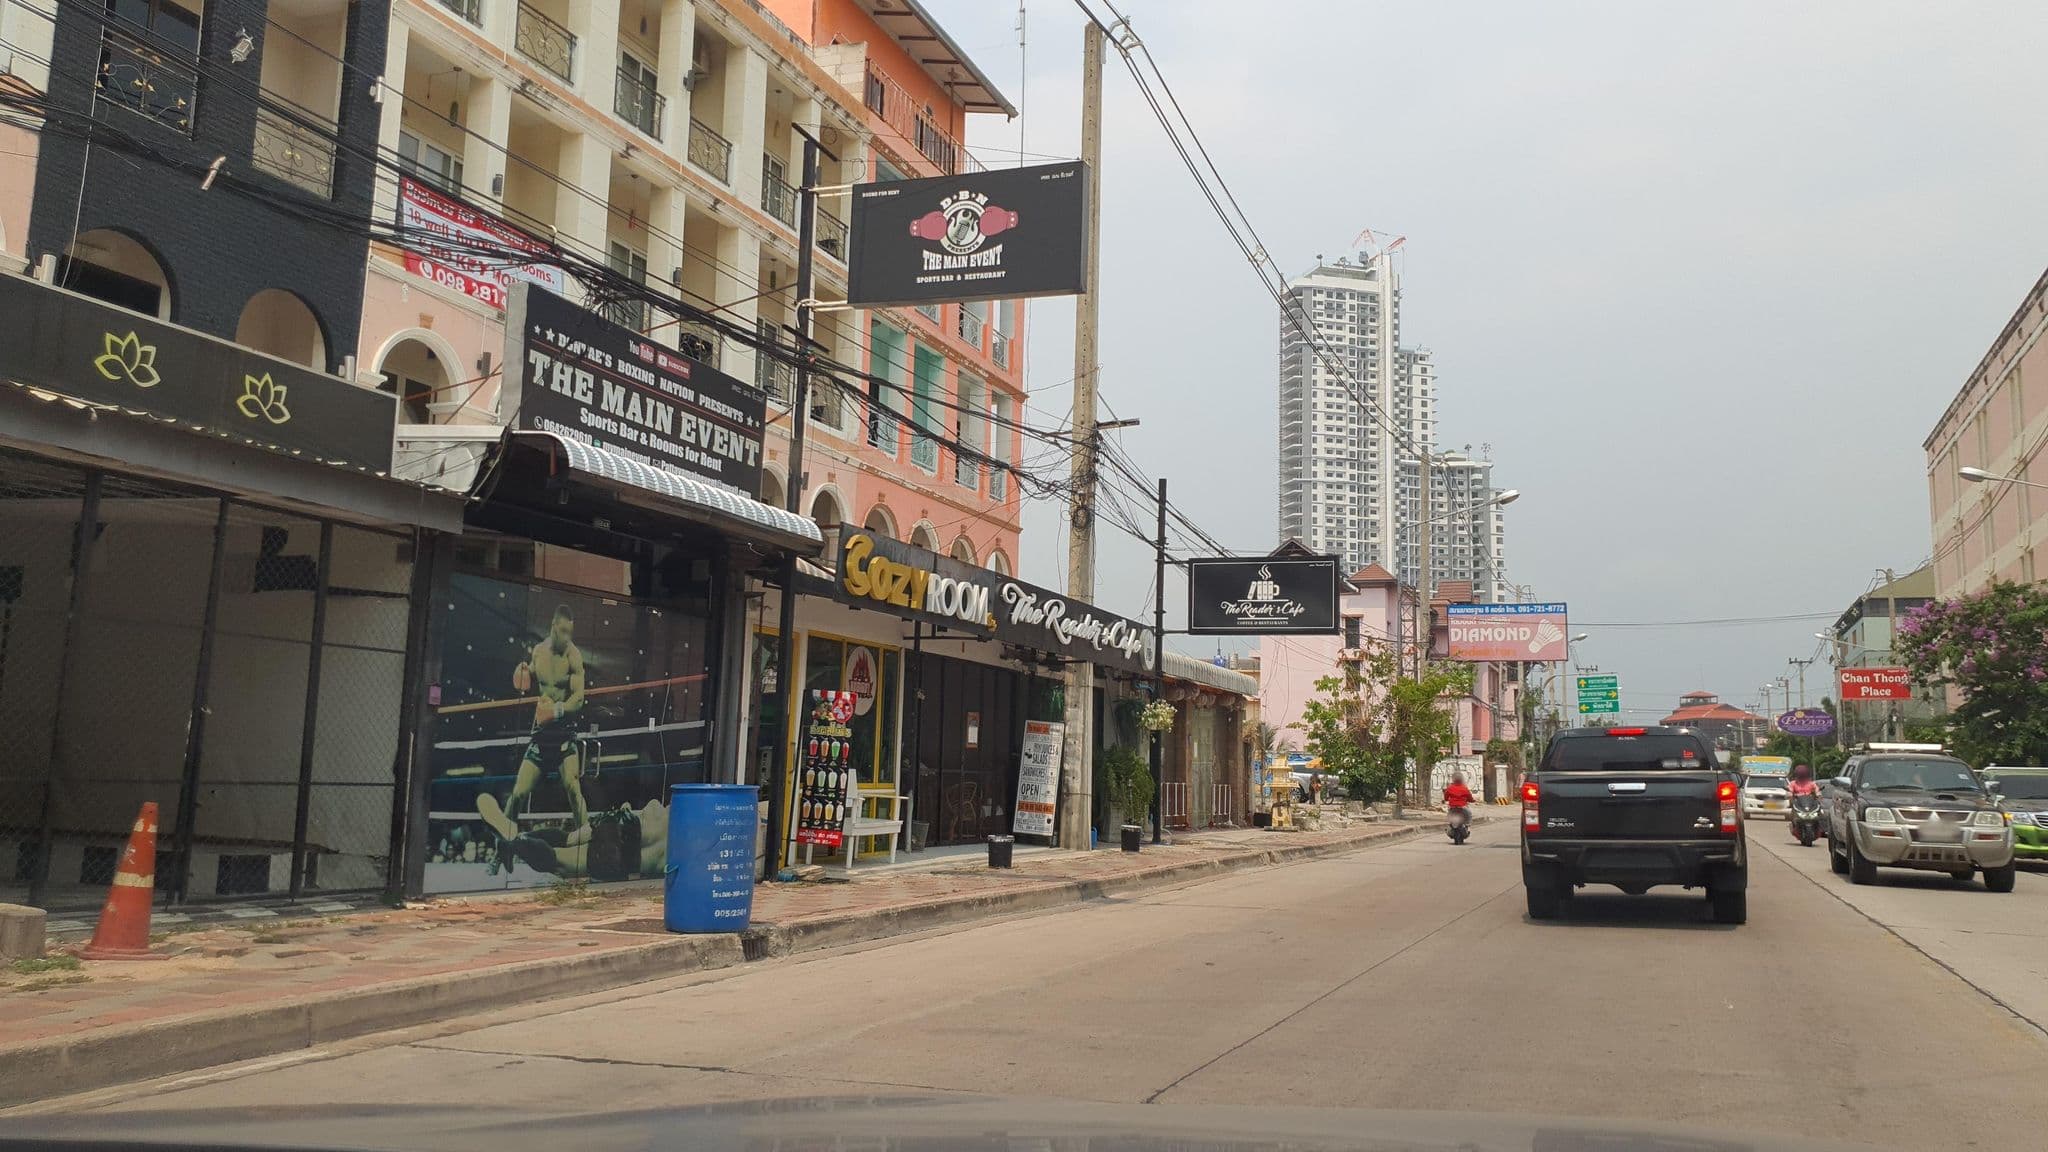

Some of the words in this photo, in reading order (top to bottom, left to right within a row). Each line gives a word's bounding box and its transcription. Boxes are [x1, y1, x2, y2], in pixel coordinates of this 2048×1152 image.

[923, 249, 942, 270] THE
[943, 254, 969, 269] MAIN
[969, 243, 1003, 268] EVENT
[436, 268, 466, 293] 098
[519, 263, 555, 285] ooms.
[916, 276, 941, 284] SPORTS
[941, 274, 954, 282] BAR
[956, 273, 962, 281] &
[964, 271, 1007, 281] RESTAURANT
[617, 359, 655, 386] BOXING
[660, 376, 695, 403] NATION
[699, 394, 744, 423] PRESENTS
[529, 349, 595, 405] THE
[601, 379, 675, 435] MAIN
[680, 410, 760, 467] EVENT
[580, 407, 619, 435] Sports
[619, 422, 640, 443] Bar
[639, 433, 649, 446] &
[649, 435, 684, 459] Rooms
[684, 446, 700, 464] for
[700, 452, 722, 472] Rent
[1220, 601, 1241, 616] The
[1240, 602, 1281, 618] Reader's
[1281, 600, 1305, 617] Cafe
[1002, 582, 1044, 626] The
[1109, 618, 1142, 659] Cafe
[1450, 627, 1531, 643] DIAMOND
[1841, 672, 1870, 683] Chan
[1873, 672, 1909, 685] Thong
[1861, 686, 1892, 696] Place
[1021, 783, 1039, 796] OPEN
